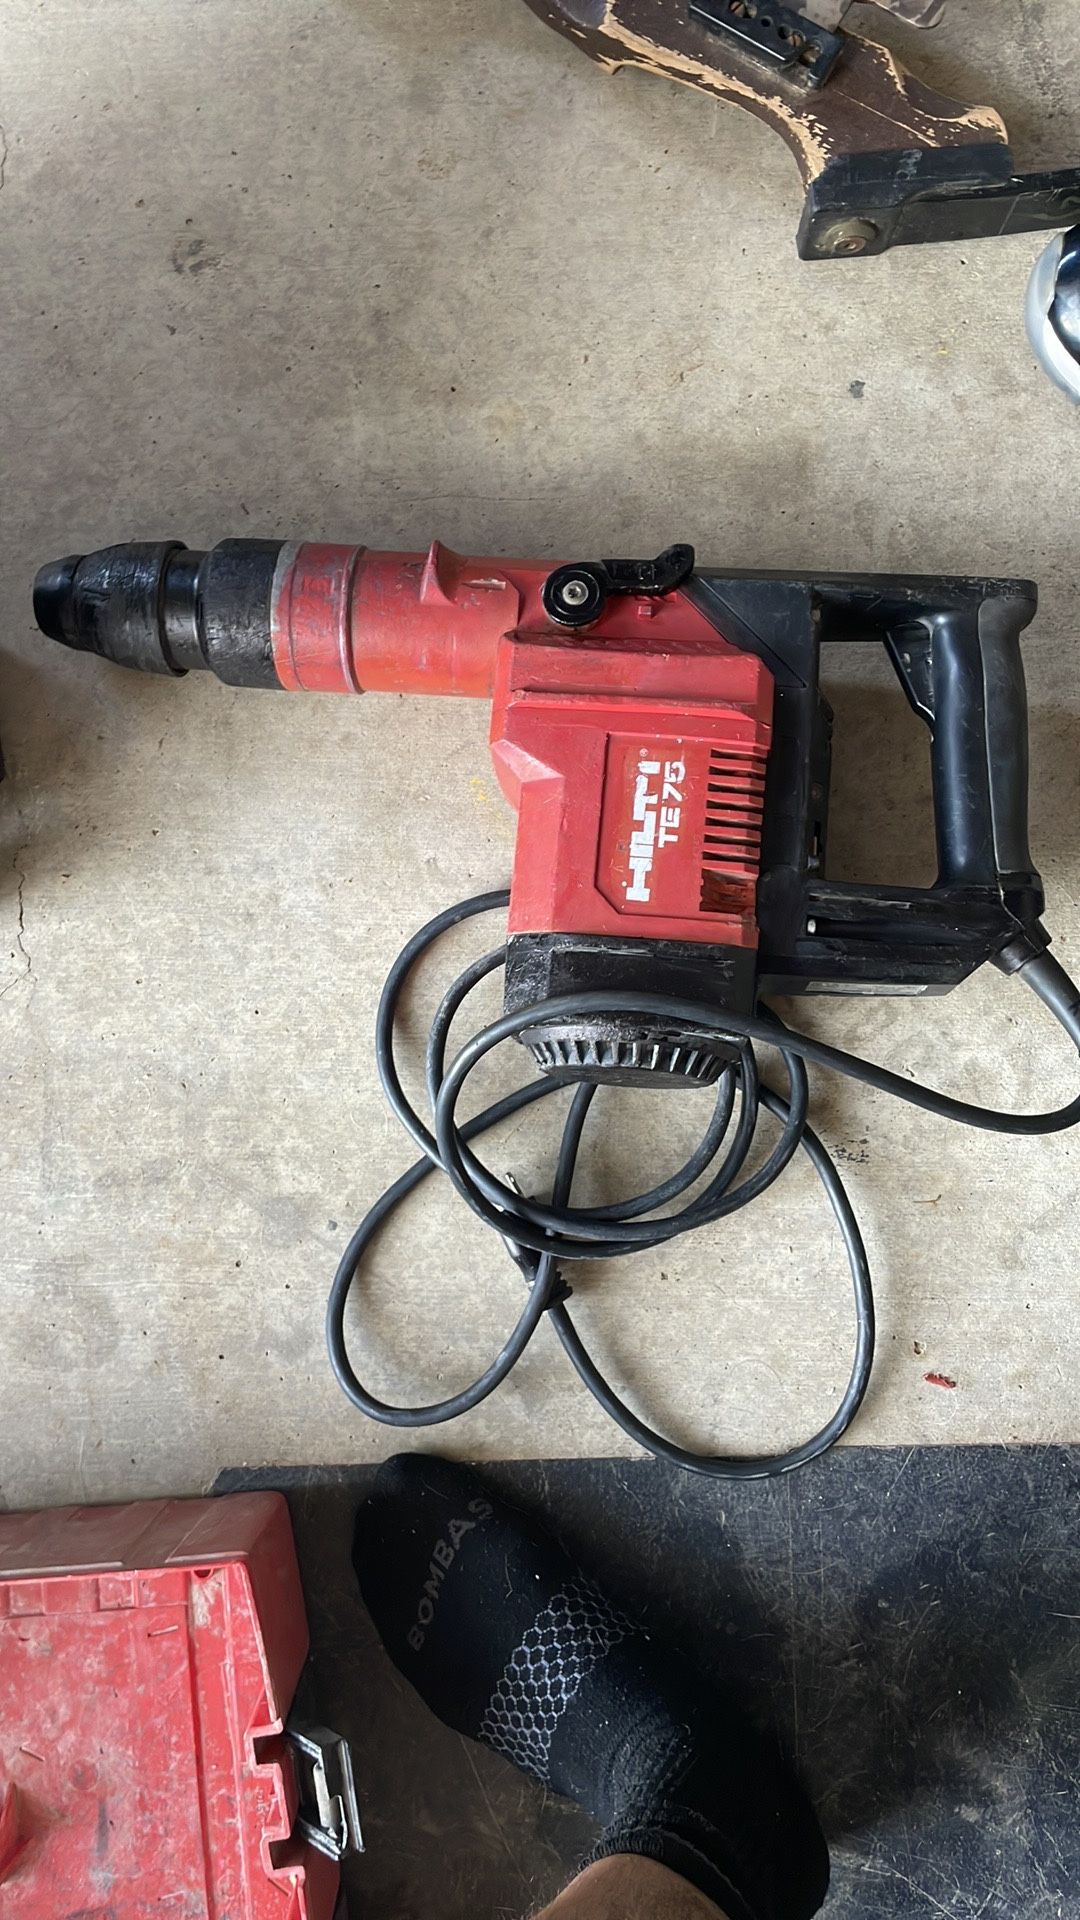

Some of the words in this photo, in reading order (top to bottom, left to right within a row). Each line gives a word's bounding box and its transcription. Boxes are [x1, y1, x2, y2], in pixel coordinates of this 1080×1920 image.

[658, 806, 681, 848] TE
[662, 761, 686, 802] 75
[626, 761, 661, 902] HILTI
[407, 1499, 494, 1651] BOMBAS
